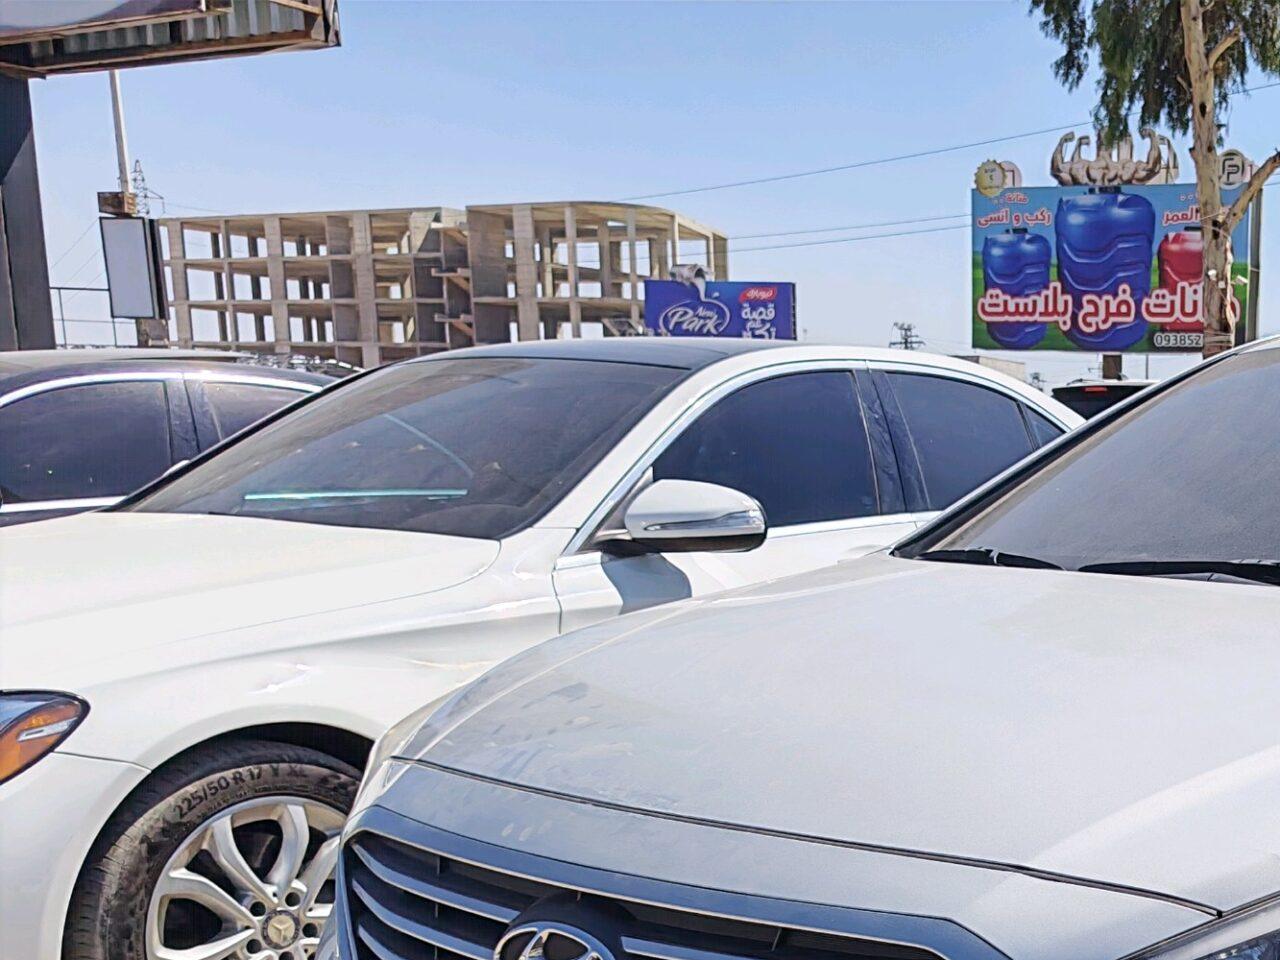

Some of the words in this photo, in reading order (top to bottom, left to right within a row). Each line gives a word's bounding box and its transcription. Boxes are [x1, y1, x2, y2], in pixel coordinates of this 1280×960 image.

[1012, 211, 1021, 226] و
[668, 307, 720, 334] Park
[977, 282, 1073, 331] بلاست
[1077, 284, 1135, 332] فرح
[1153, 334, 1203, 347] 093852
[174, 776, 230, 819] 225/50
[232, 771, 246, 785] R
[249, 766, 262, 782] 17
